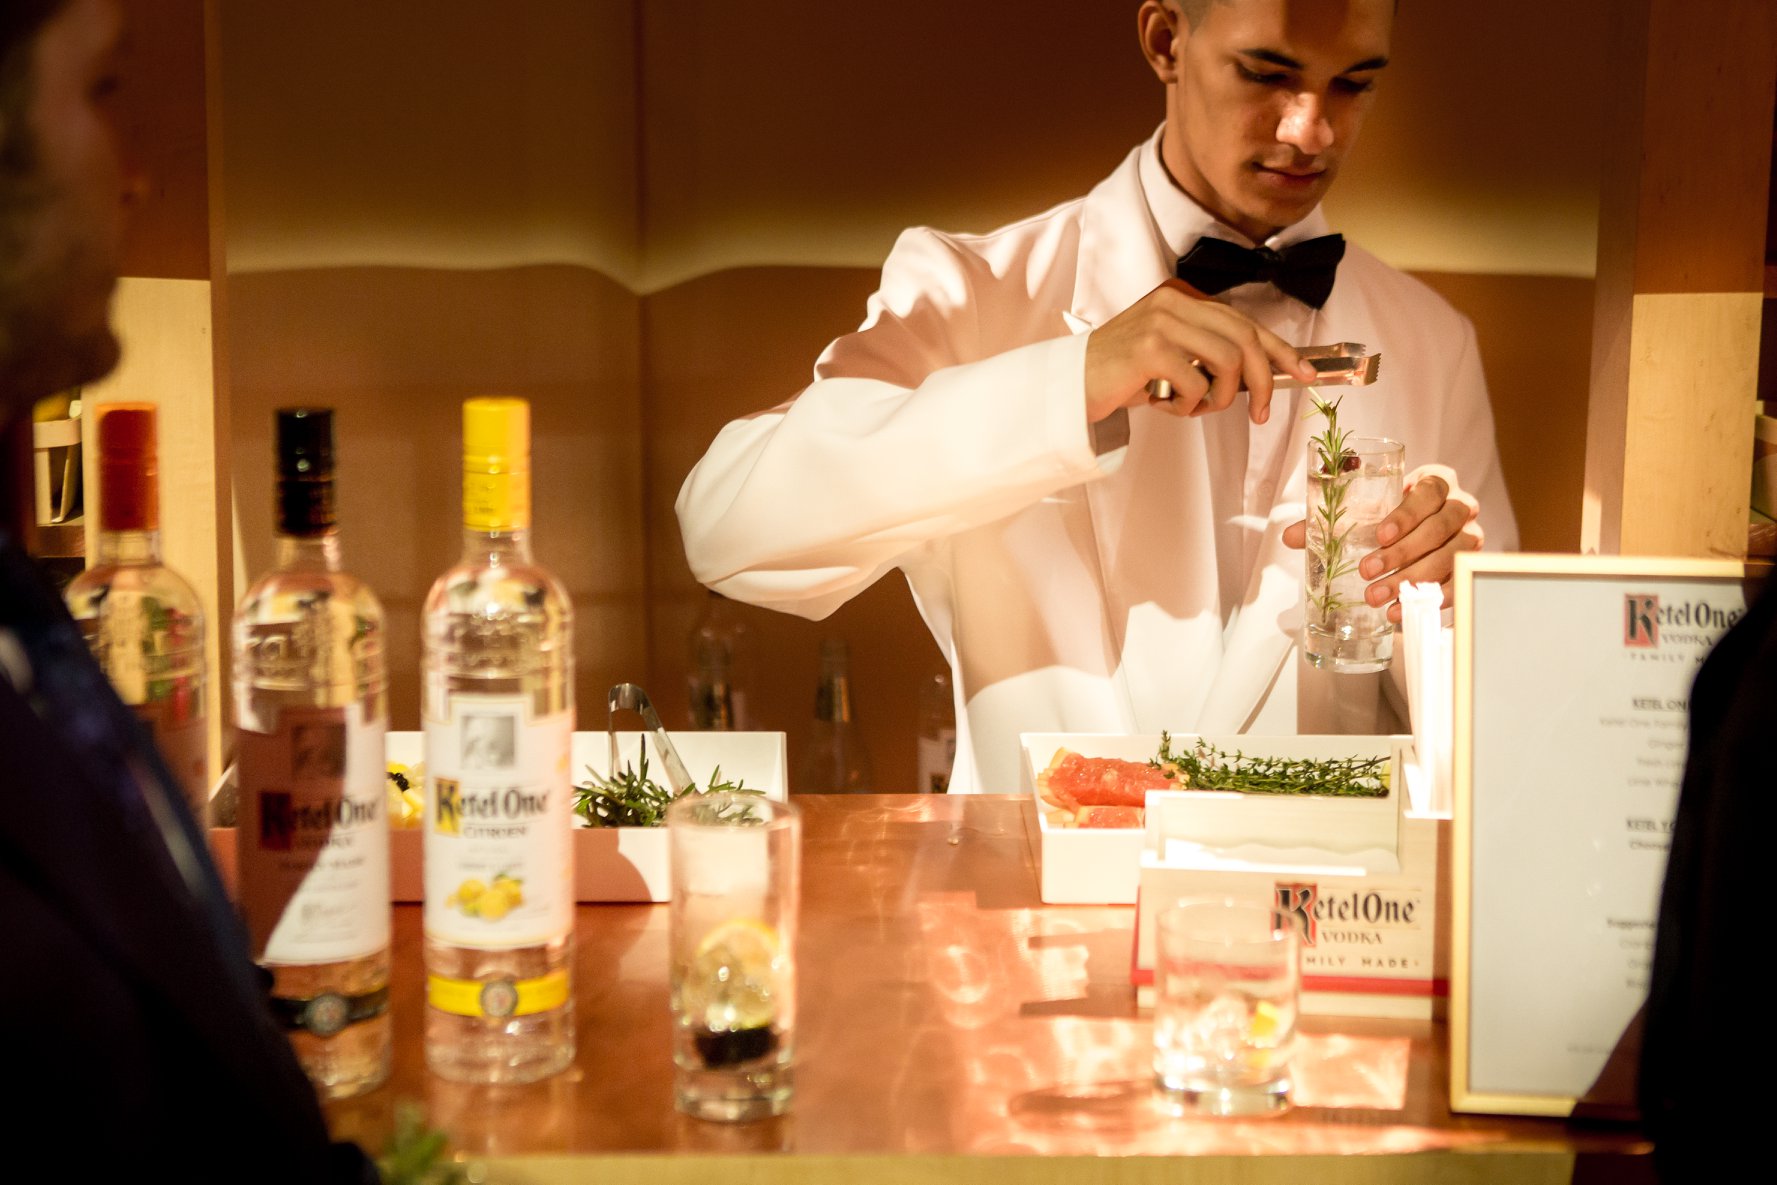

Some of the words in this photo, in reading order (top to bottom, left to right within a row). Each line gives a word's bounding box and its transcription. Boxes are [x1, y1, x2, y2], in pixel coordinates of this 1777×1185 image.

[1626, 597, 1691, 648] Ketel
[435, 780, 499, 833] Ketel
[1276, 887, 1359, 945] Ketel
[1362, 891, 1414, 923] One
[1322, 931, 1383, 945] VODKA
[1305, 957, 1346, 967] MILY
